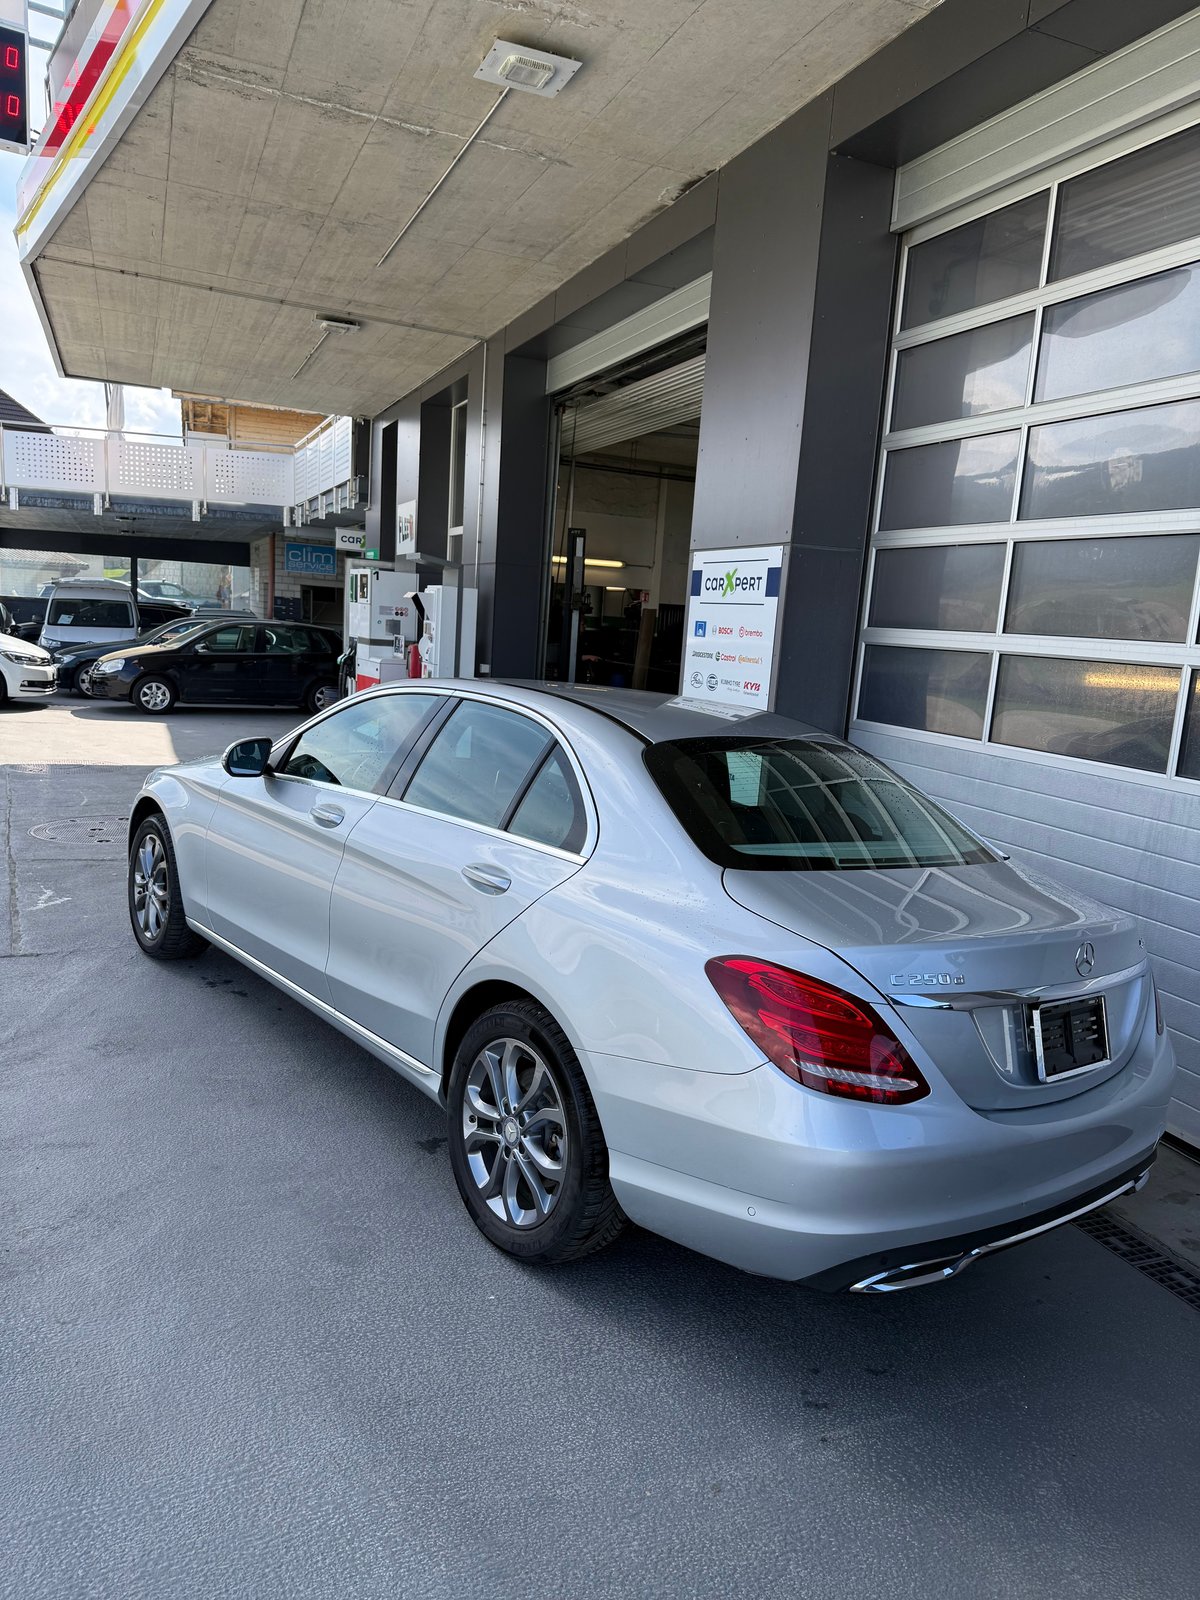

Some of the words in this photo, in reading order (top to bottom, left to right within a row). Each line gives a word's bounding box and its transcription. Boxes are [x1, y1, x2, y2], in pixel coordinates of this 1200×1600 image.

[288, 547, 333, 564] clim
[288, 560, 333, 571] service
[372, 571, 380, 581] 1
[718, 626, 733, 635] BOSCH
[745, 629, 763, 637] brembo
[720, 653, 737, 662] Castrol
[743, 681, 761, 691] KYB
[890, 974, 905, 986] C
